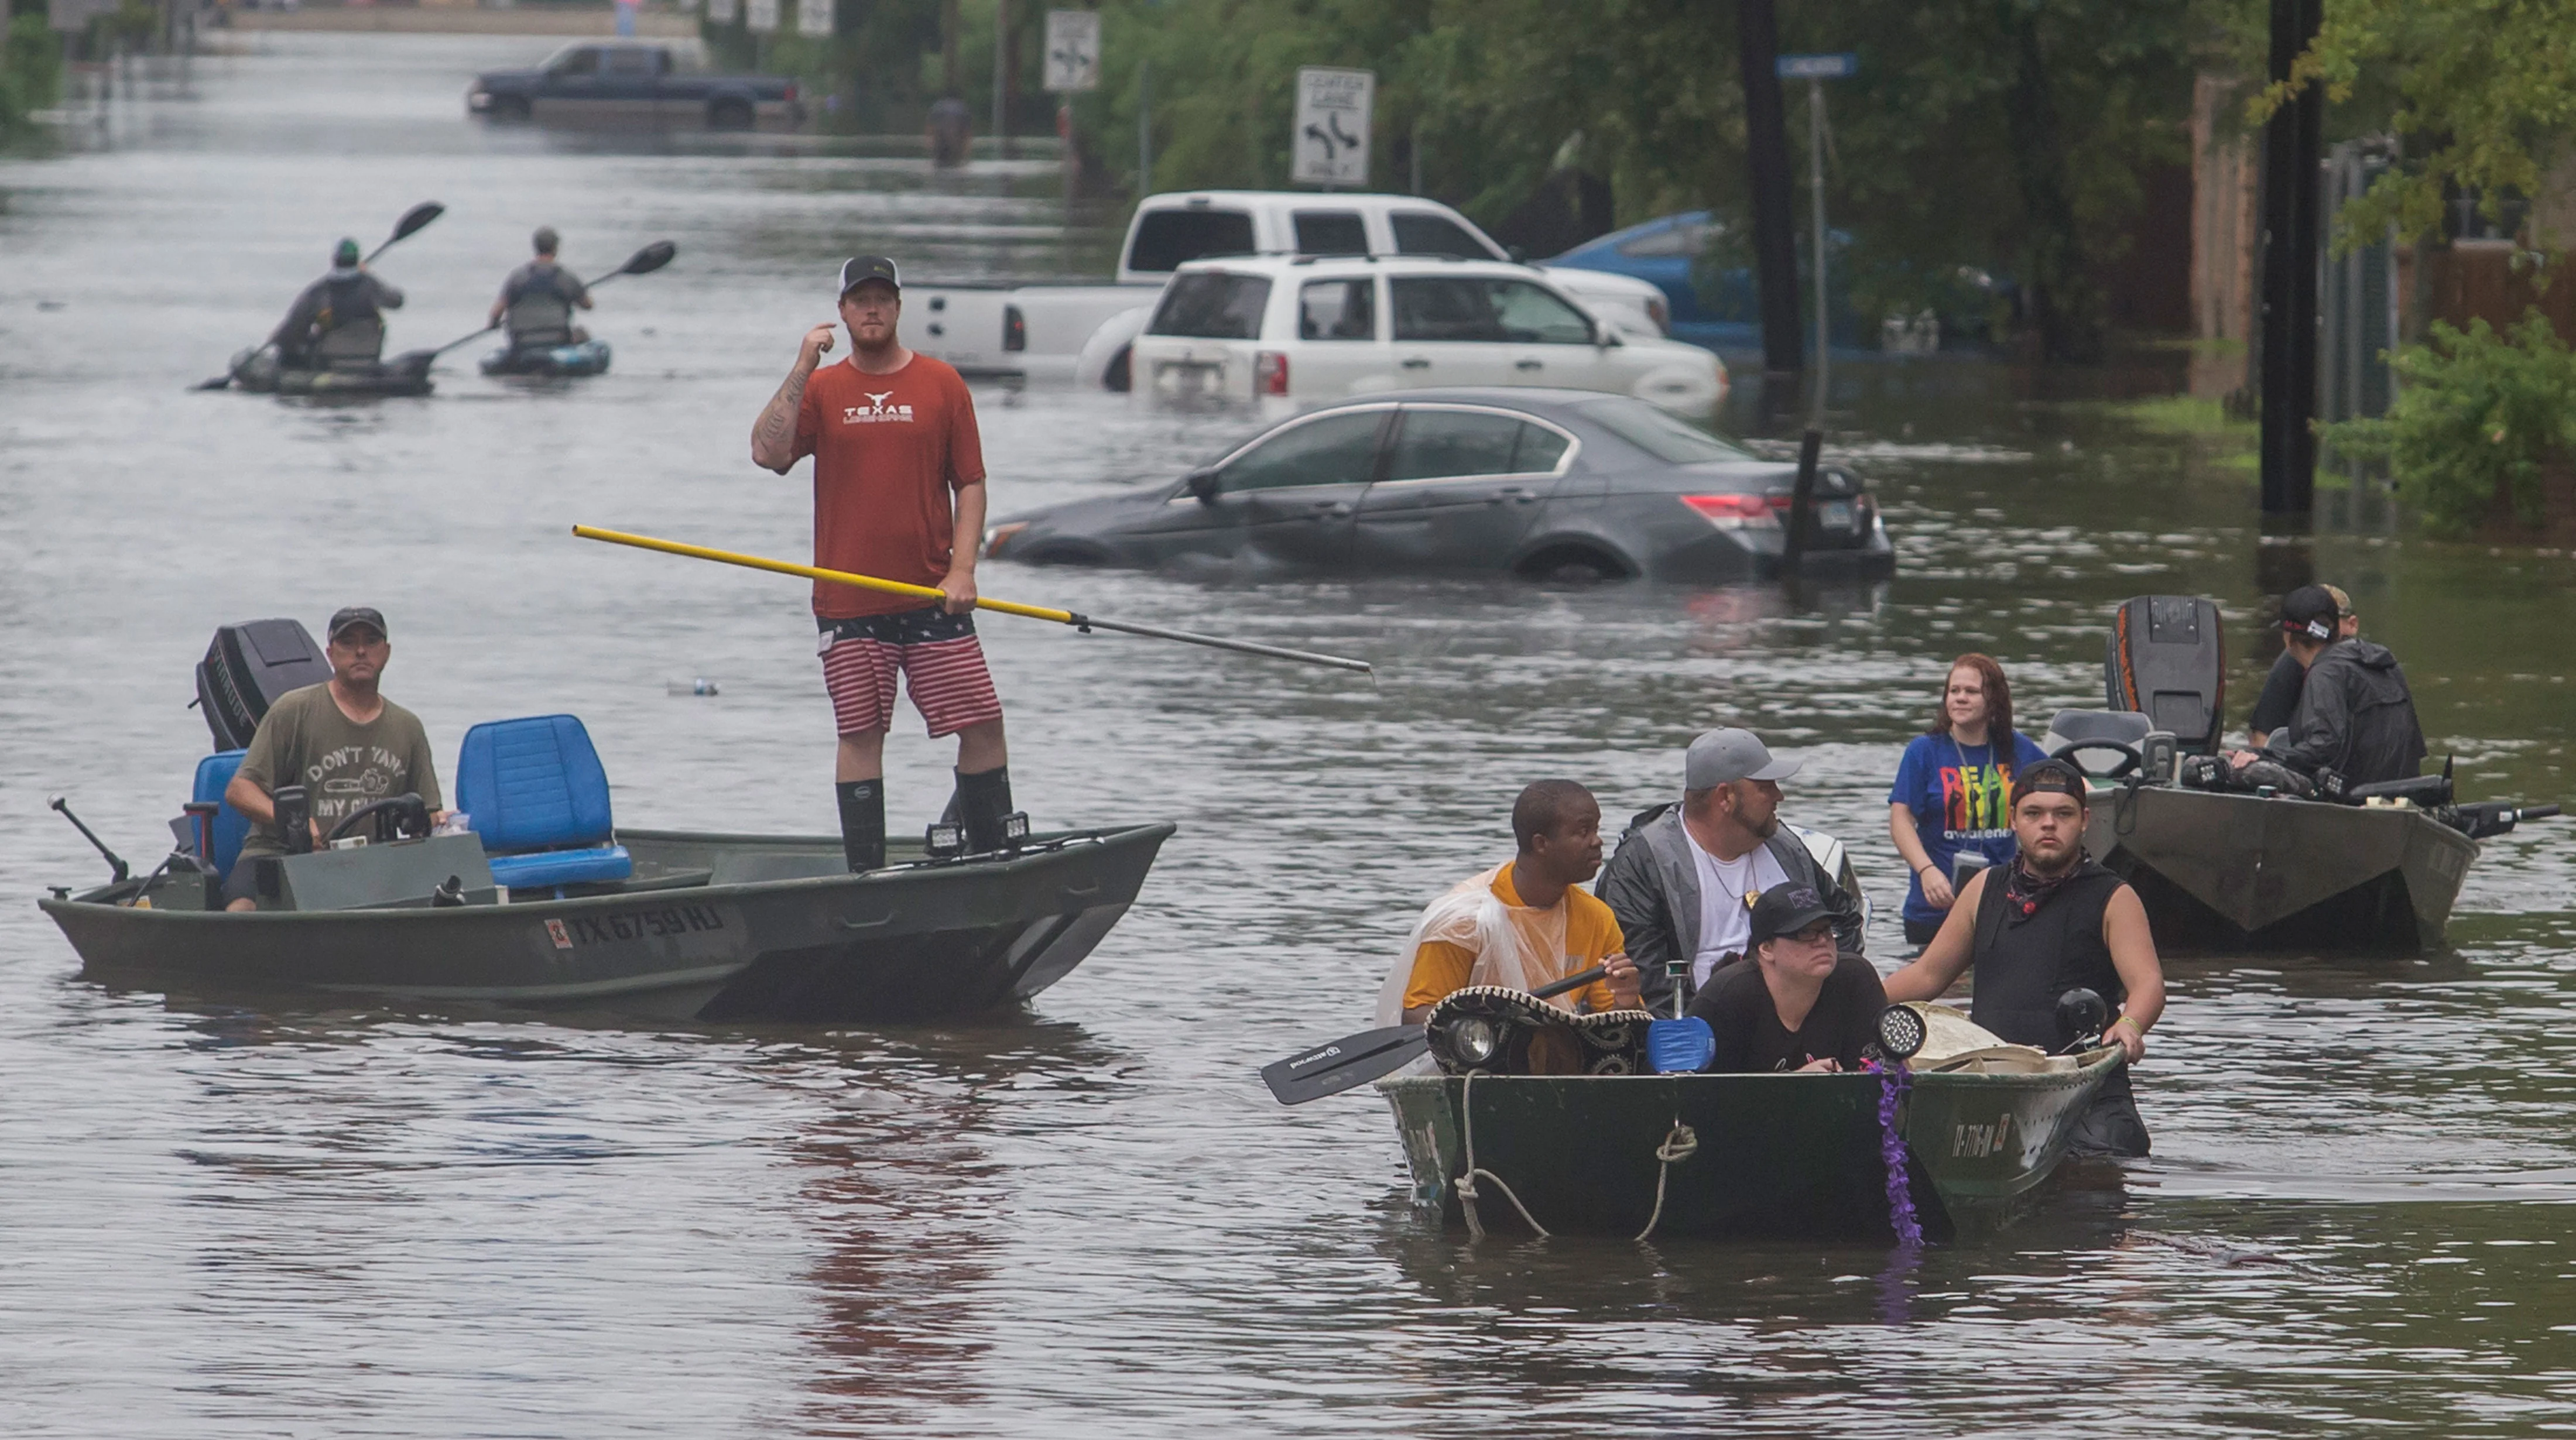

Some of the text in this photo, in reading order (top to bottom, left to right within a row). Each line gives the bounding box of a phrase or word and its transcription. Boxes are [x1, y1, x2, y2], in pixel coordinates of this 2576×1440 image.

[844, 404, 912, 417] TEXAS
[307, 746, 363, 782] DON'T
[317, 798, 345, 817] MY
